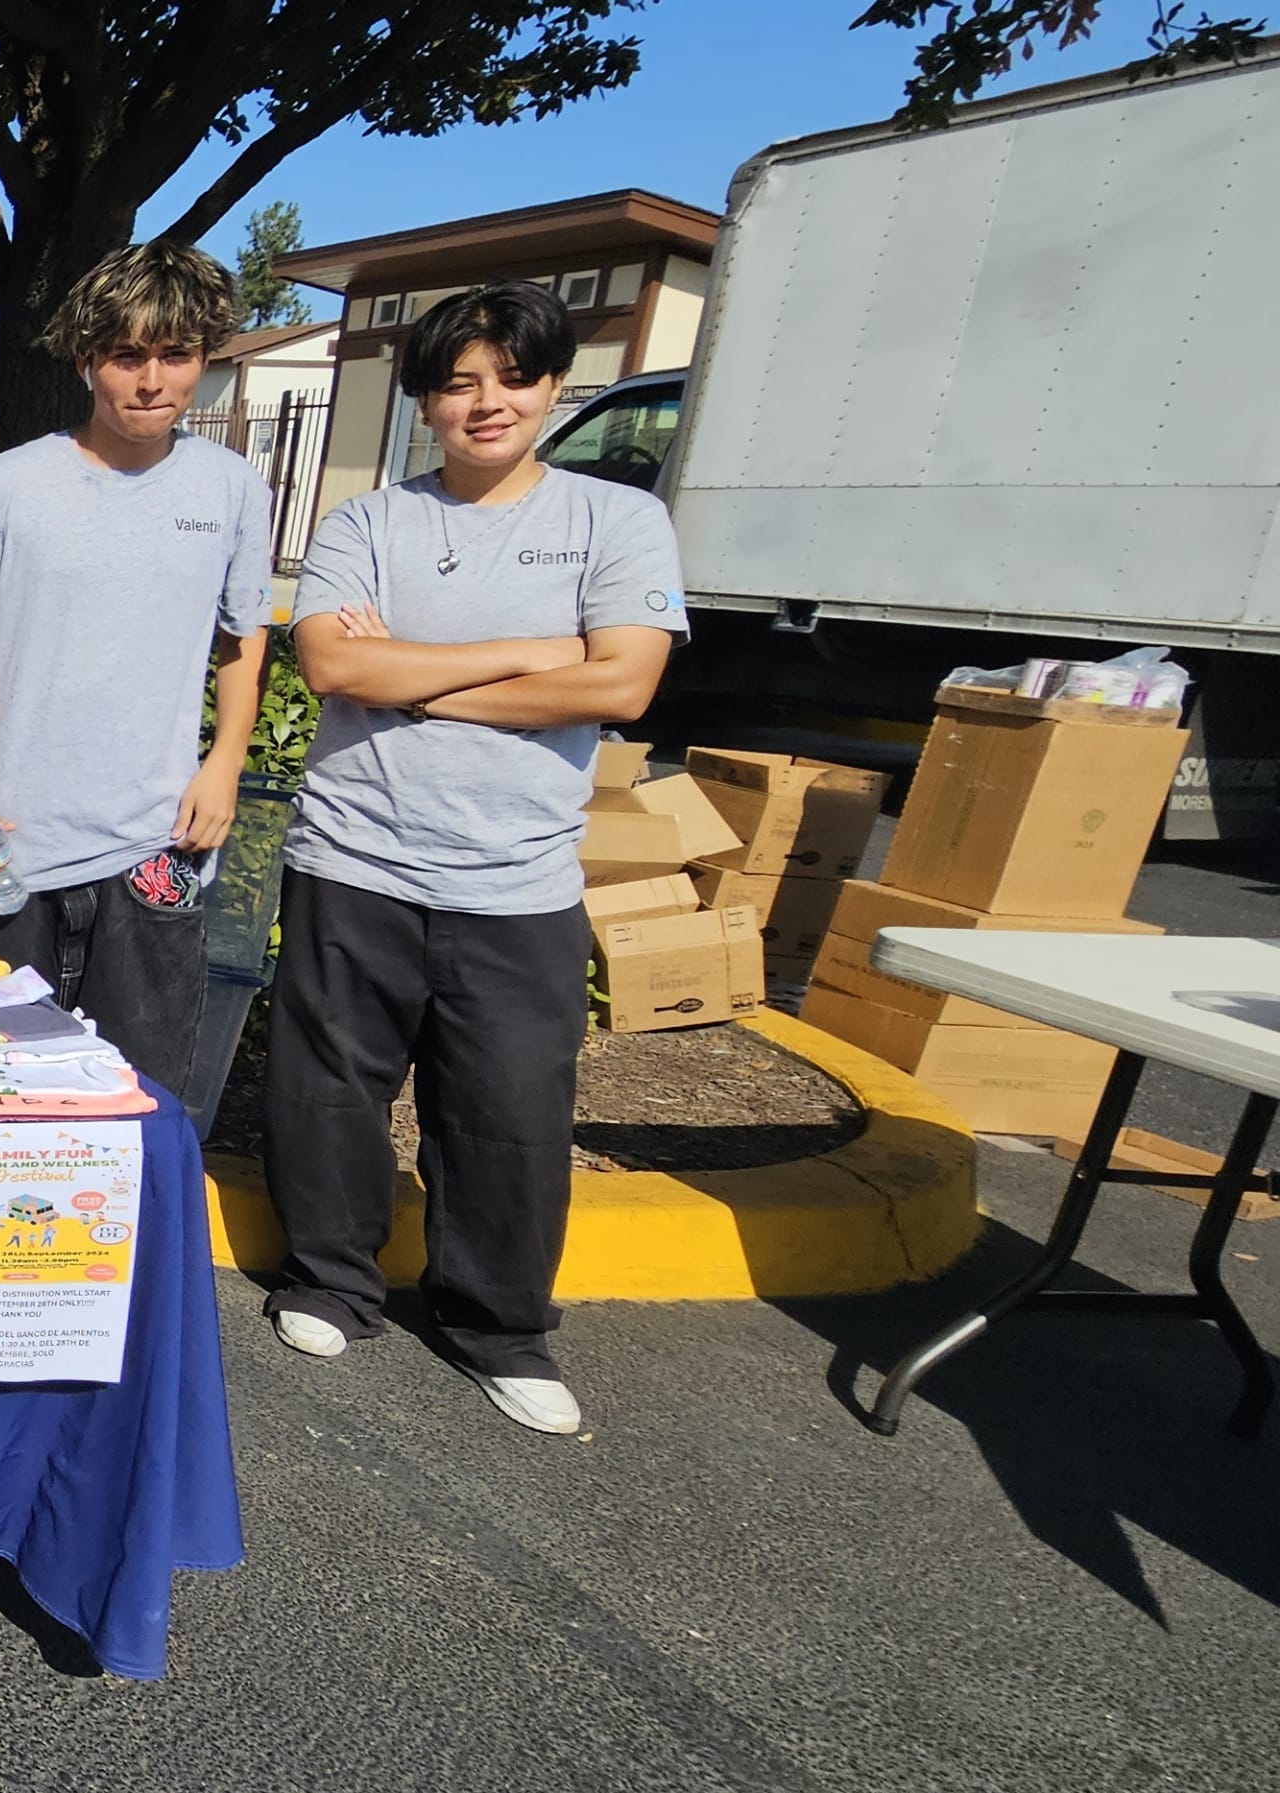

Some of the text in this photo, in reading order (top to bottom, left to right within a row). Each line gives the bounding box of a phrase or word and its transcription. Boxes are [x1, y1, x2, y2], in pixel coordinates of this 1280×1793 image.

[54, 1149, 93, 1159] FUN
[42, 1159, 120, 1168] WELLNESS
[1, 1290, 61, 1298] DISTRIBUTION
[62, 1289, 83, 1297] WILL
[16, 1330, 46, 1338] BANCO
[47, 1329, 58, 1337] DE
[60, 1329, 111, 1337] ALIMENTOS
[56, 1339, 77, 1347] 28TH
[32, 1349, 55, 1357] SOLO
